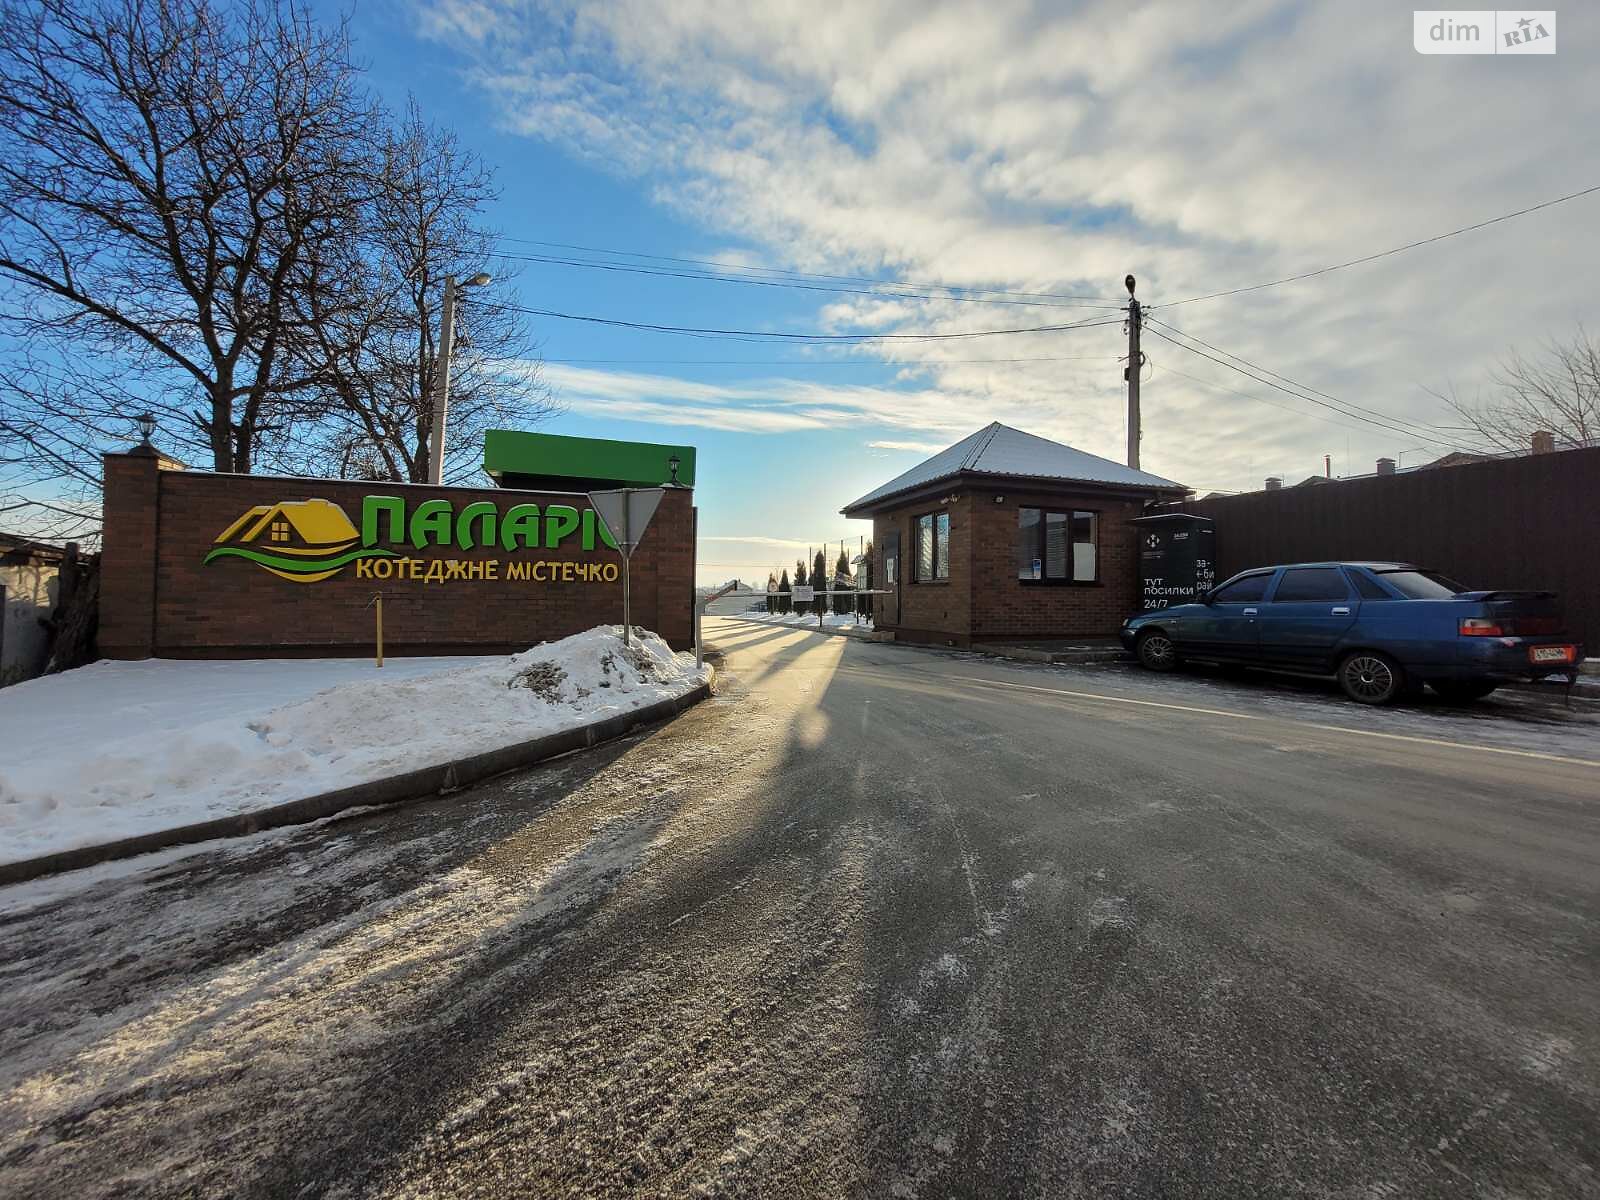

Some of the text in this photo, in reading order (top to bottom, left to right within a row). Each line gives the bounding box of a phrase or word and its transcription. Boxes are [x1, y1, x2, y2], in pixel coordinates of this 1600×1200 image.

[356, 556, 620, 584] КОТЕДЖНЕ МІСТЕЧКО
[1143, 599, 1168, 609] 24/7
